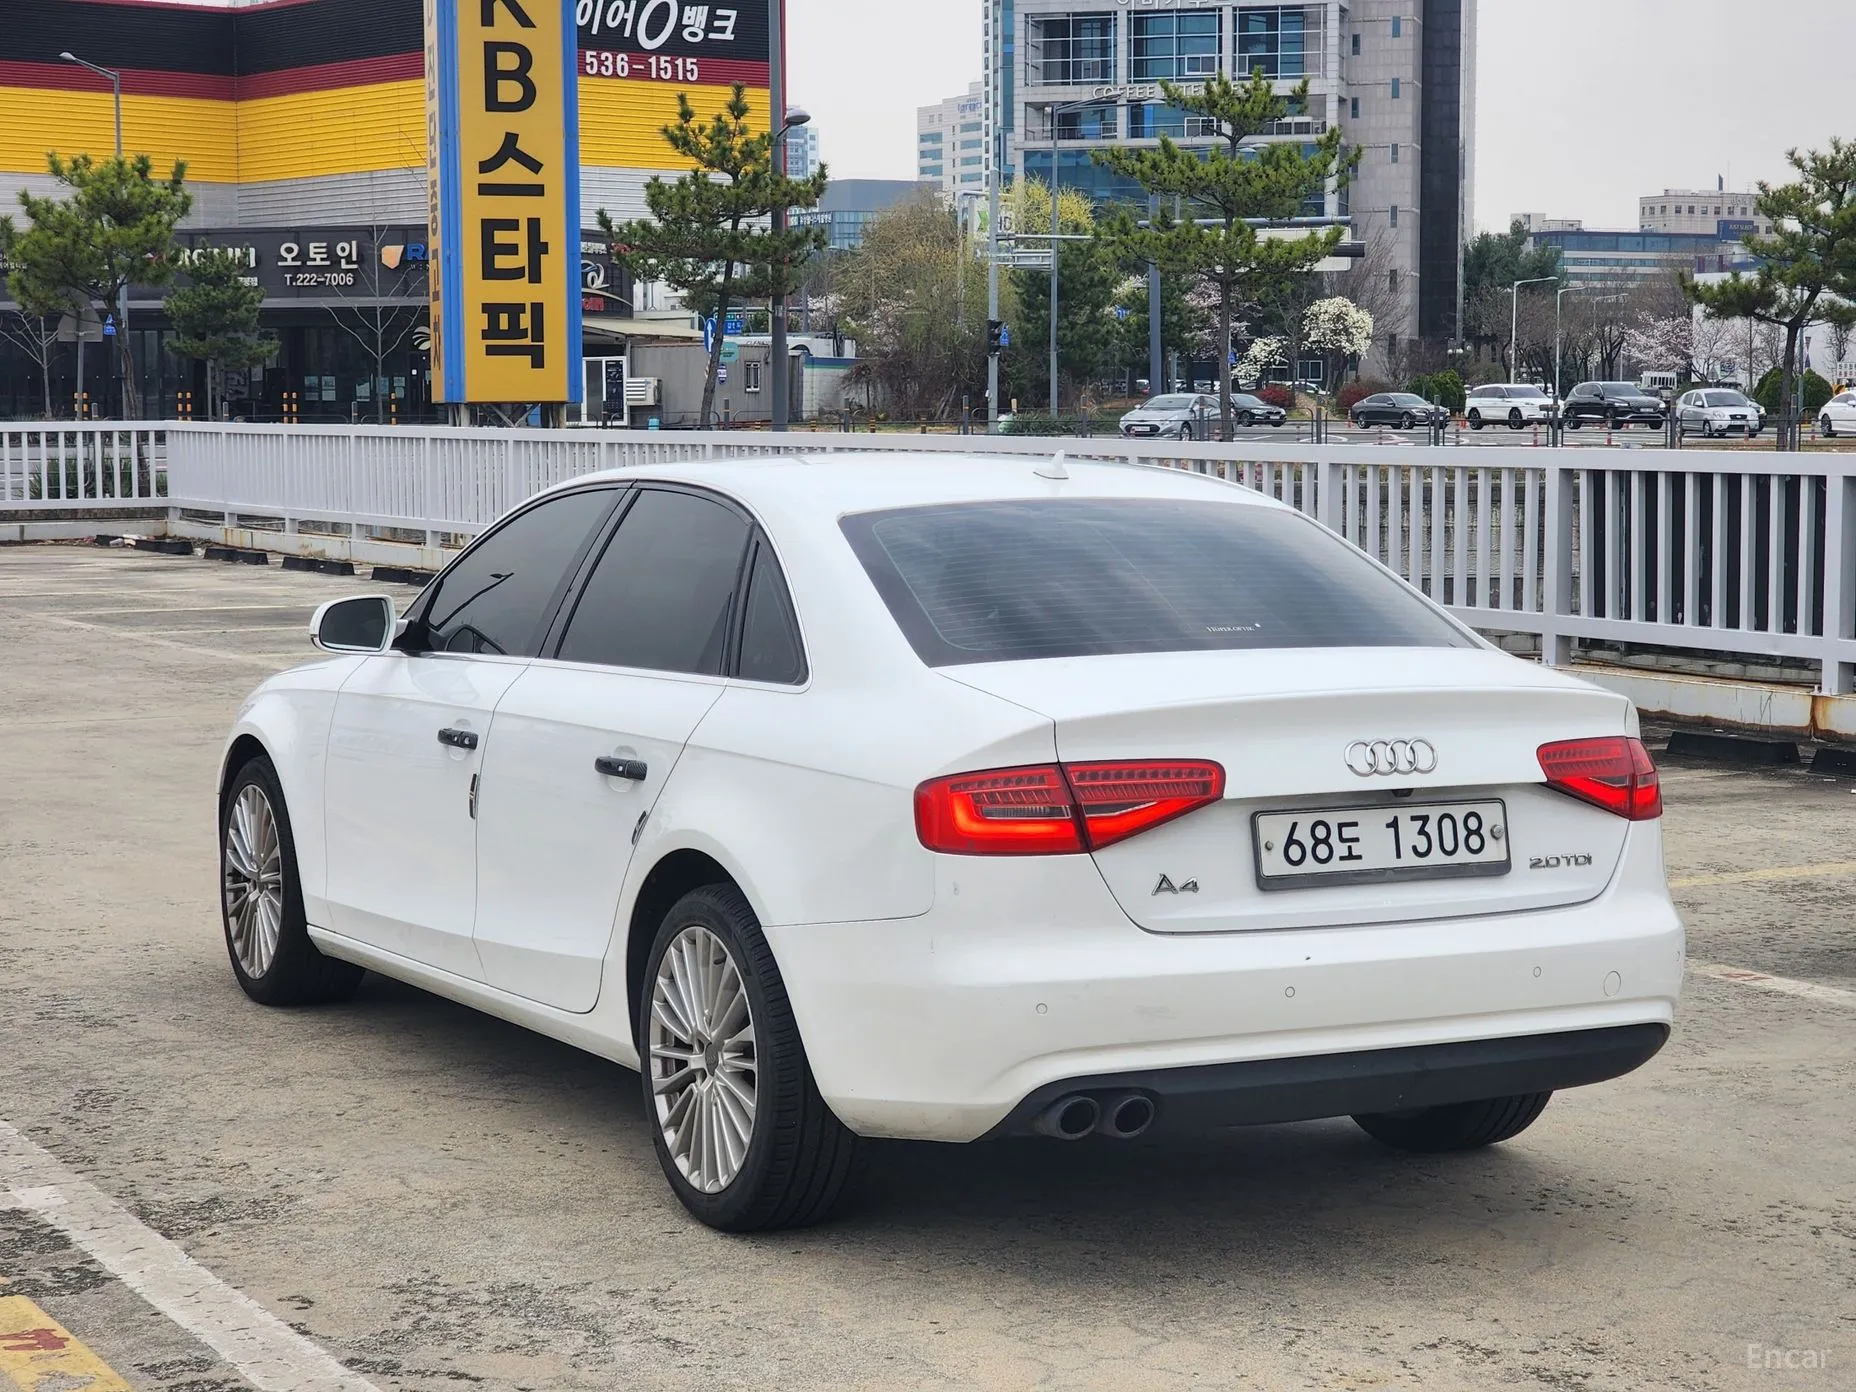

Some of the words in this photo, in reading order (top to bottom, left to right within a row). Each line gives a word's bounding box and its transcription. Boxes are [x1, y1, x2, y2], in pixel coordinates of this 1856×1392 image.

[585, 50, 700, 82] 536-1515
[277, 240, 359, 270] 오토인
[284, 273, 355, 286] T.222-7006
[1283, 819, 1363, 867] 68도
[1385, 811, 1486, 860] 1308
[1151, 873, 1200, 896] A4
